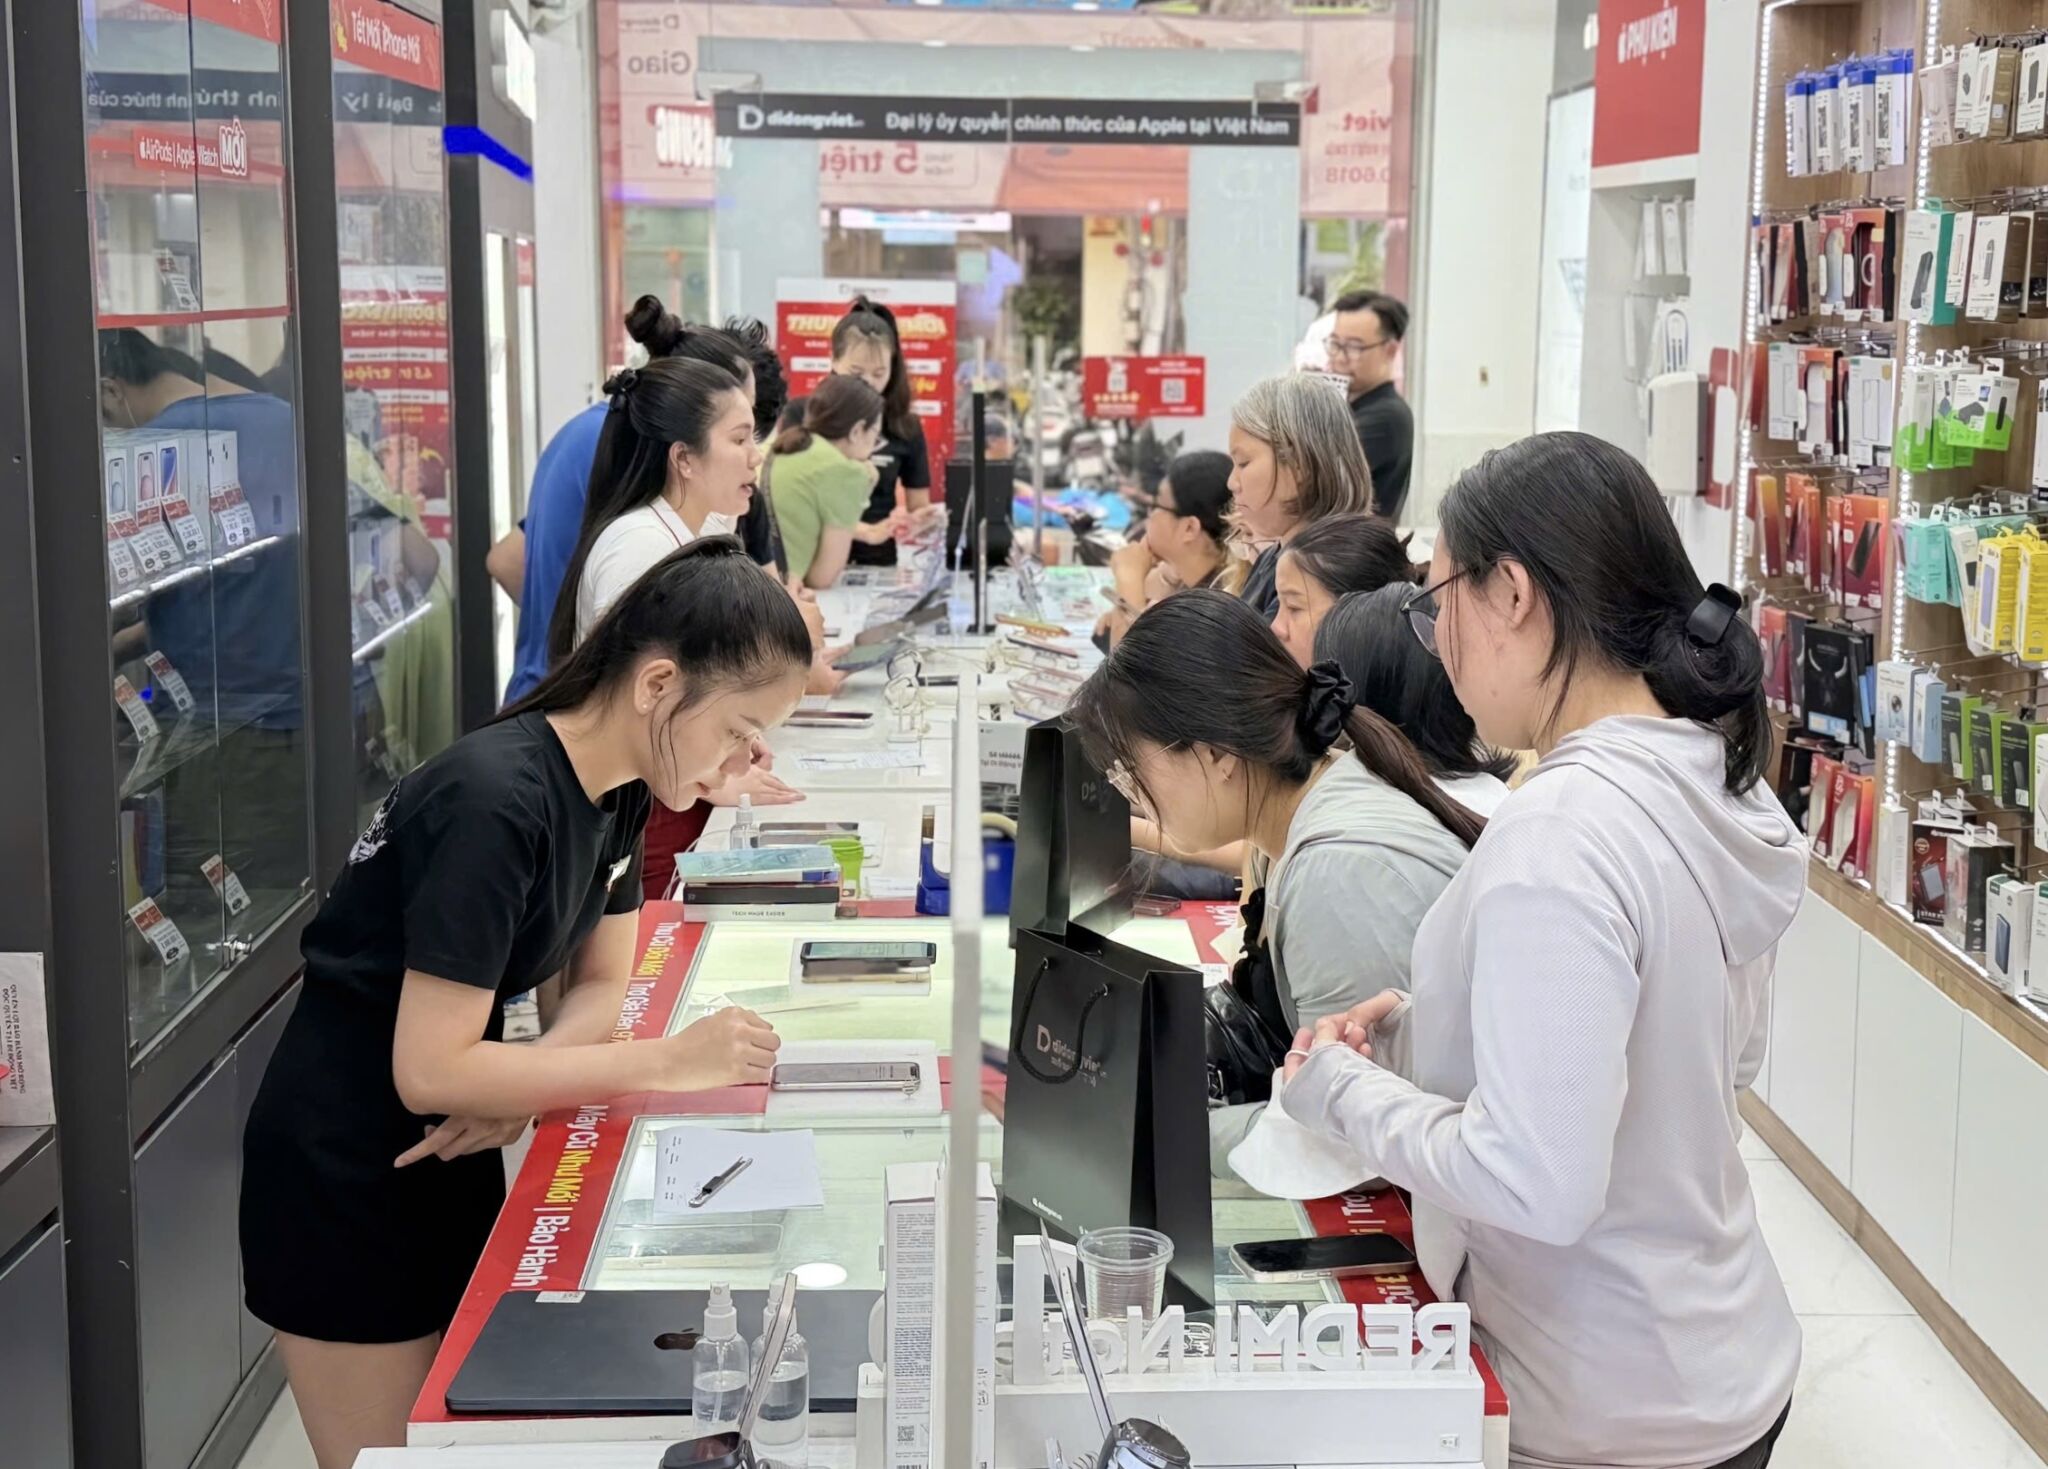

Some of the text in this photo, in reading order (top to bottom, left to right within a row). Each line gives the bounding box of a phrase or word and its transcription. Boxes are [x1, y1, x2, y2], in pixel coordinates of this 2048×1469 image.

[885, 112, 915, 132] Đại
[918, 112, 933, 133] lý
[959, 111, 1009, 134] quyền
[1014, 115, 1061, 133] chính
[1064, 114, 1102, 132] thức
[1105, 114, 1137, 133] của
[1138, 115, 1187, 136] Apple
[1189, 116, 1211, 136] tại
[1213, 115, 1249, 136] Việt
[1250, 117, 1290, 135] Nam
[144, 138, 172, 164] AirPods
[176, 143, 195, 168] Apple
[220, 116, 247, 175] MỚI
[1036, 1024, 1051, 1053] D
[566, 1105, 609, 1131] Máy
[564, 1130, 600, 1150] Cũ
[554, 1149, 594, 1178] Như
[543, 1177, 584, 1204] Mới
[528, 1215, 571, 1244] Bảo
[510, 1245, 560, 1288] Hành
